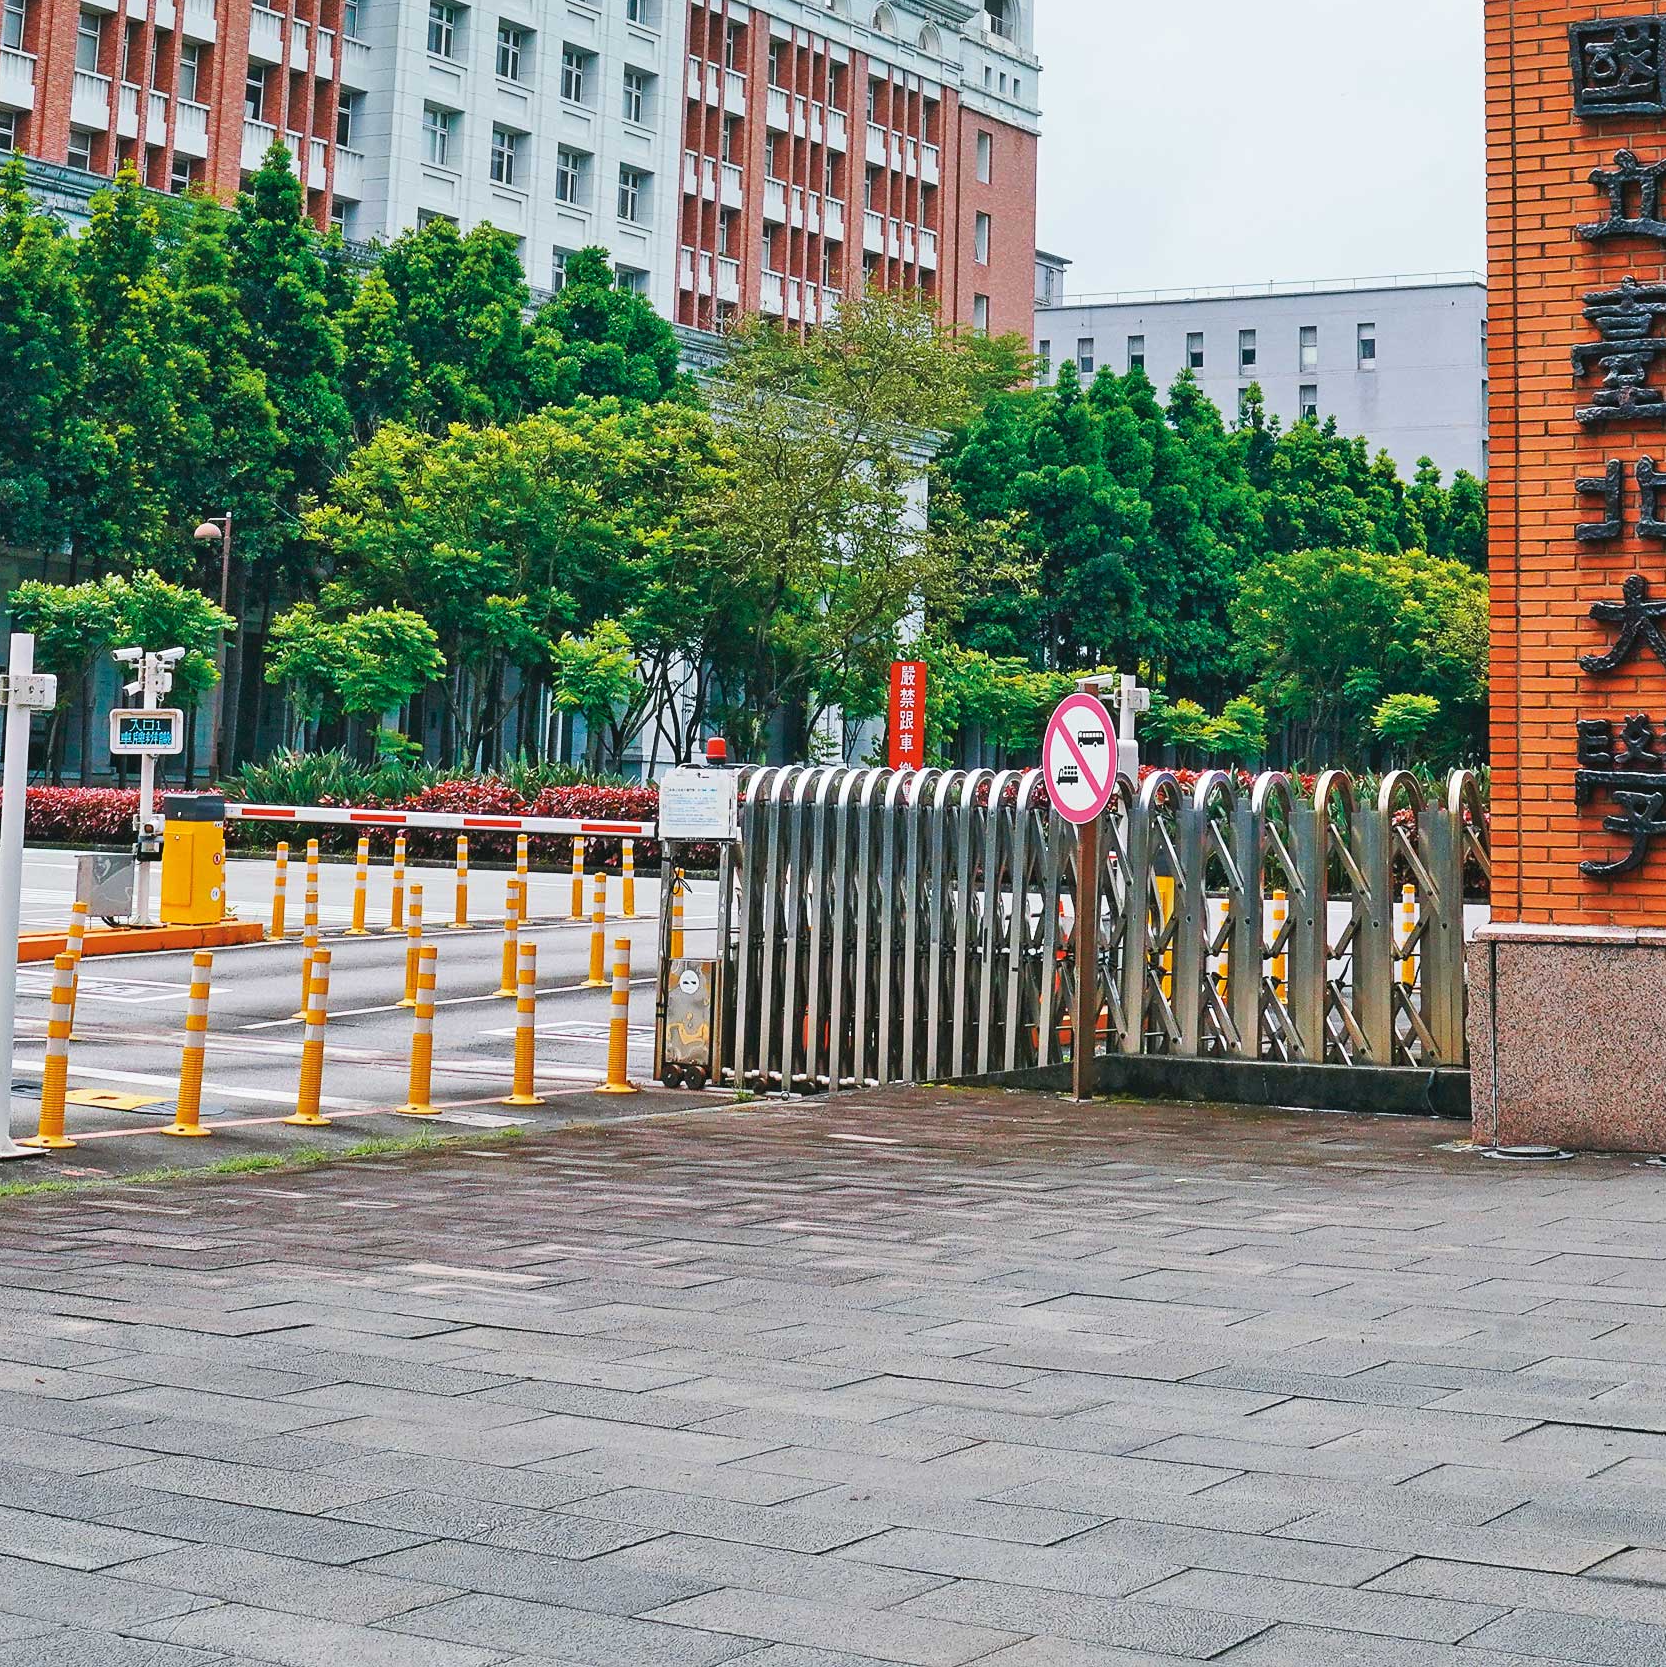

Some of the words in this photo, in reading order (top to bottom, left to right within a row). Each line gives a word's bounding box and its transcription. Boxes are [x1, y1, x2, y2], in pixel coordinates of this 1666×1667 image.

[129, 719, 162, 732] 入口1
[899, 665, 916, 753] 嚴禁跟車
